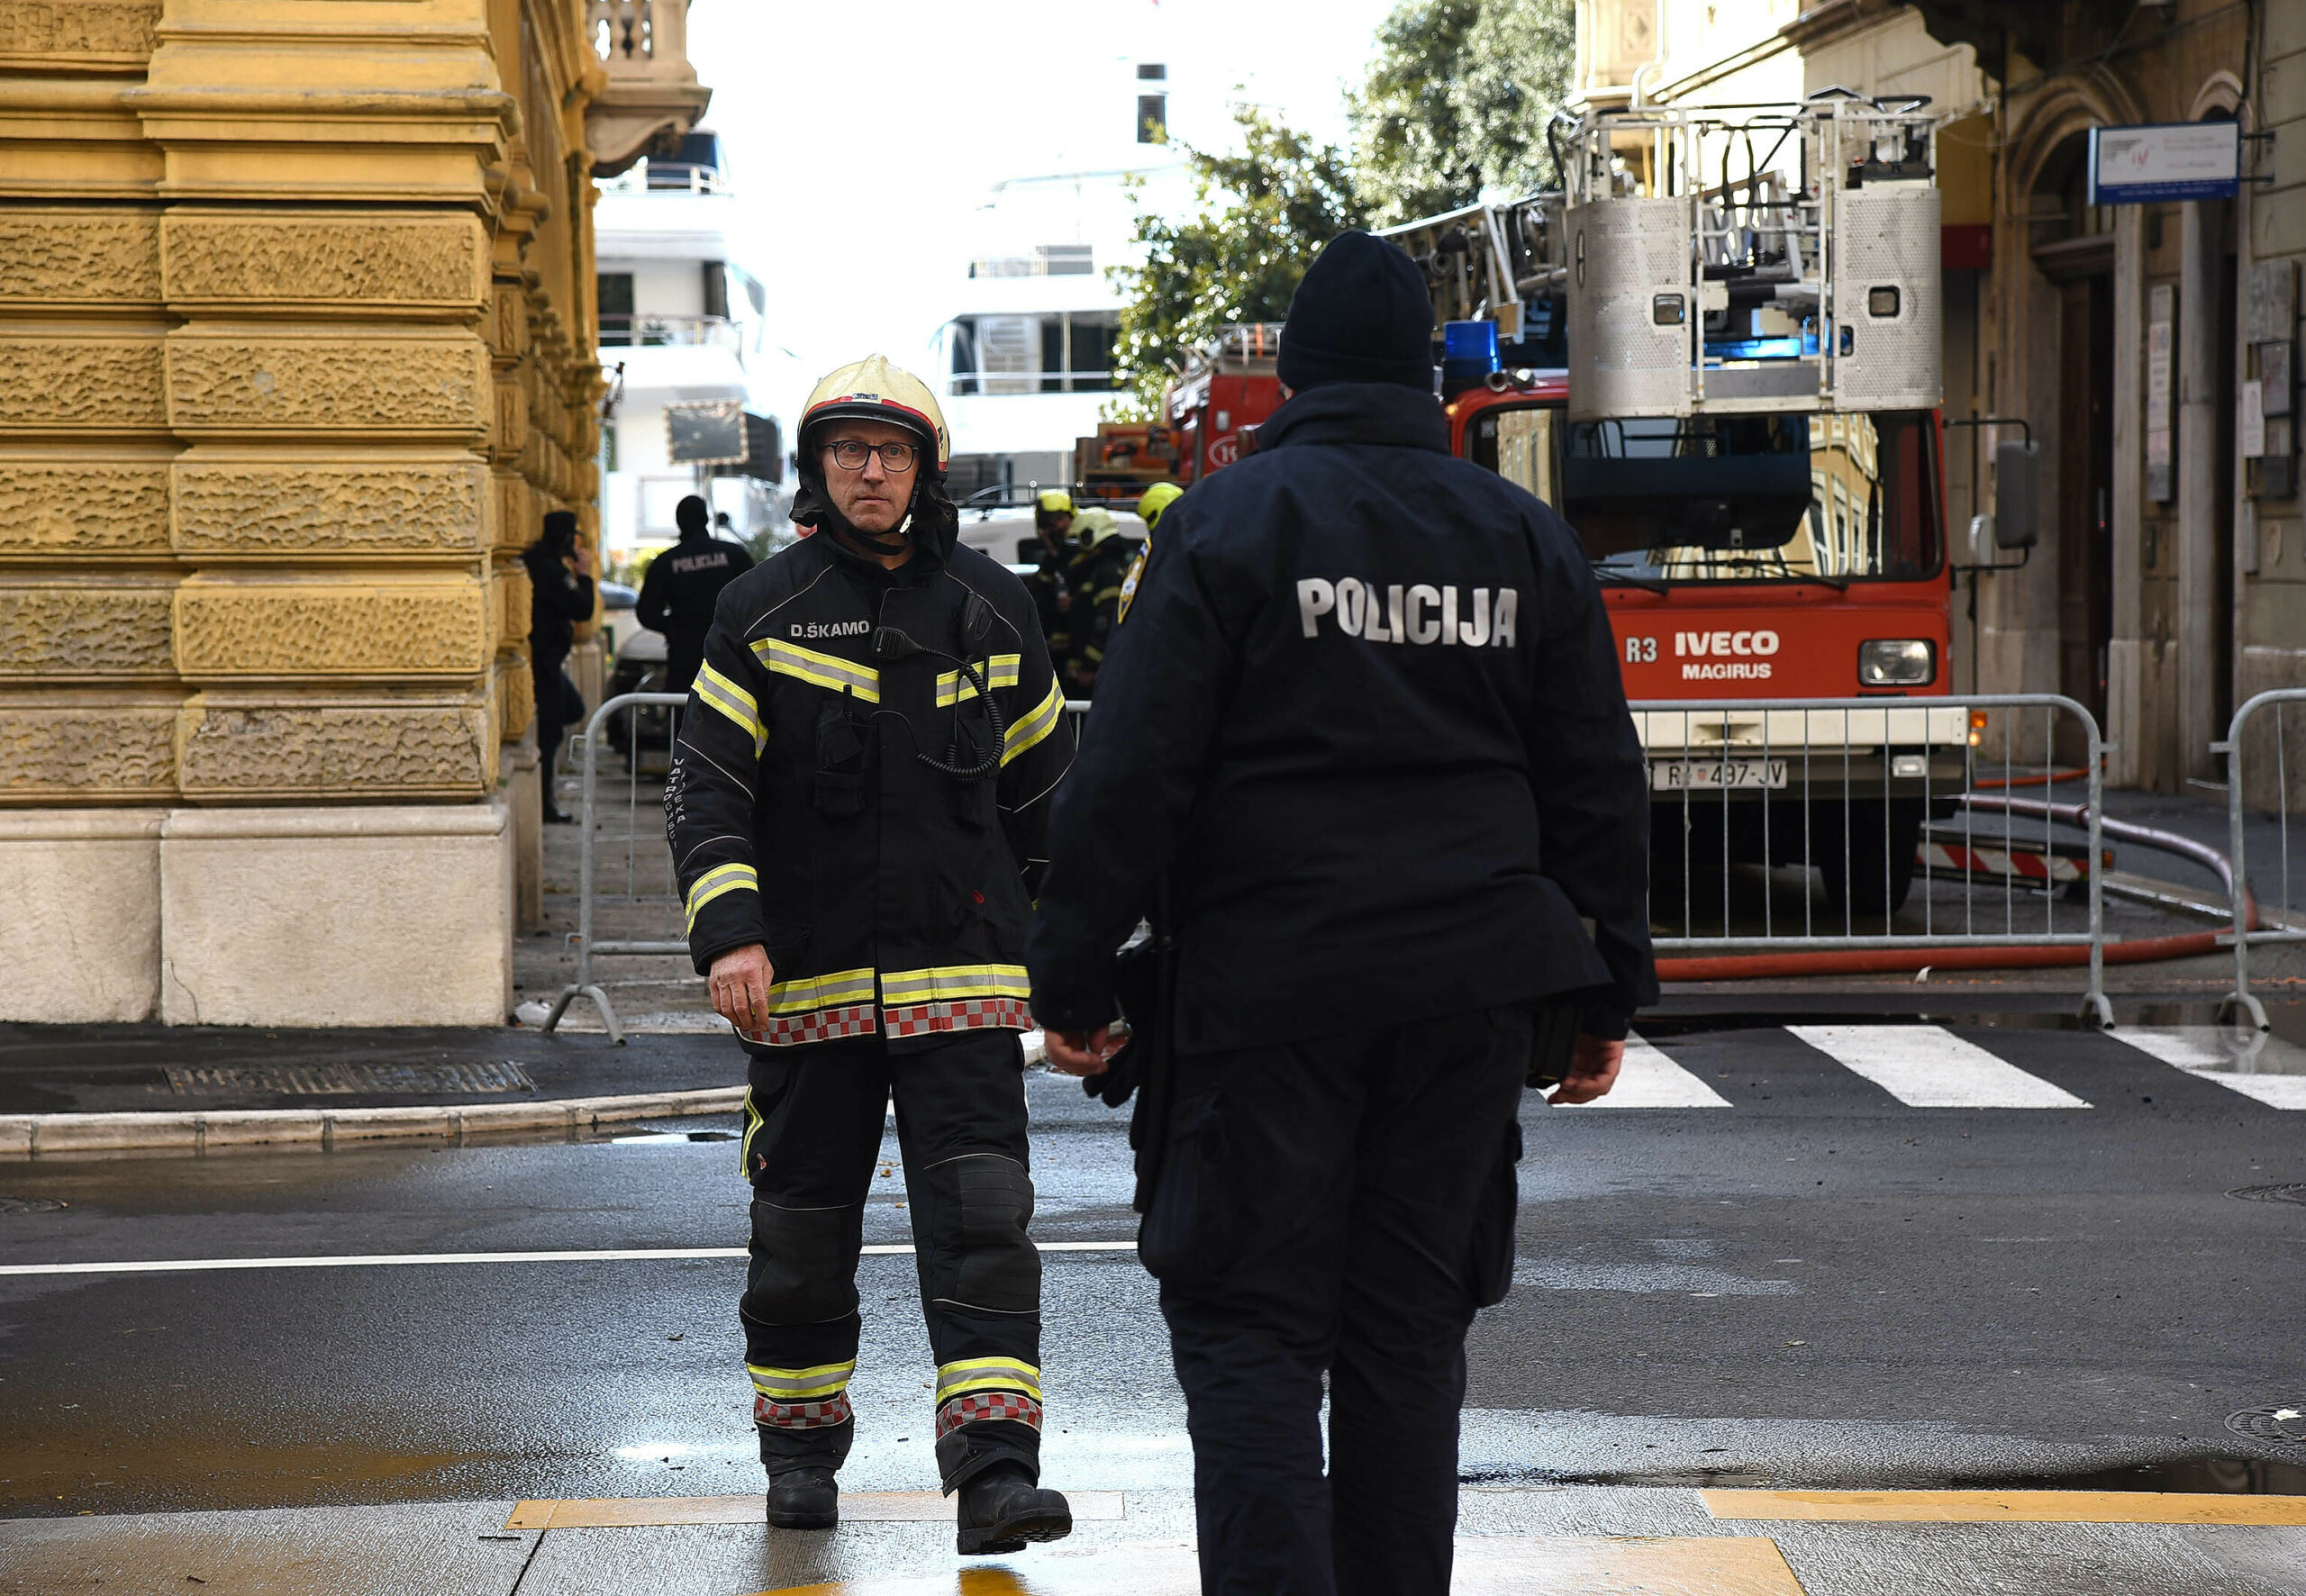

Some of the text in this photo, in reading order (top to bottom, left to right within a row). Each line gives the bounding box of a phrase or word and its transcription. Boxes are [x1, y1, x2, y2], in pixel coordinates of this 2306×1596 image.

[672, 551, 729, 573] POLICIJA
[1297, 576, 1518, 648] POLICIJA
[790, 620, 870, 639] D.ŠKAMO
[1625, 636, 1658, 663] R3
[1675, 630, 1780, 657] IVECO
[1682, 663, 1772, 680] MAGIRUS
